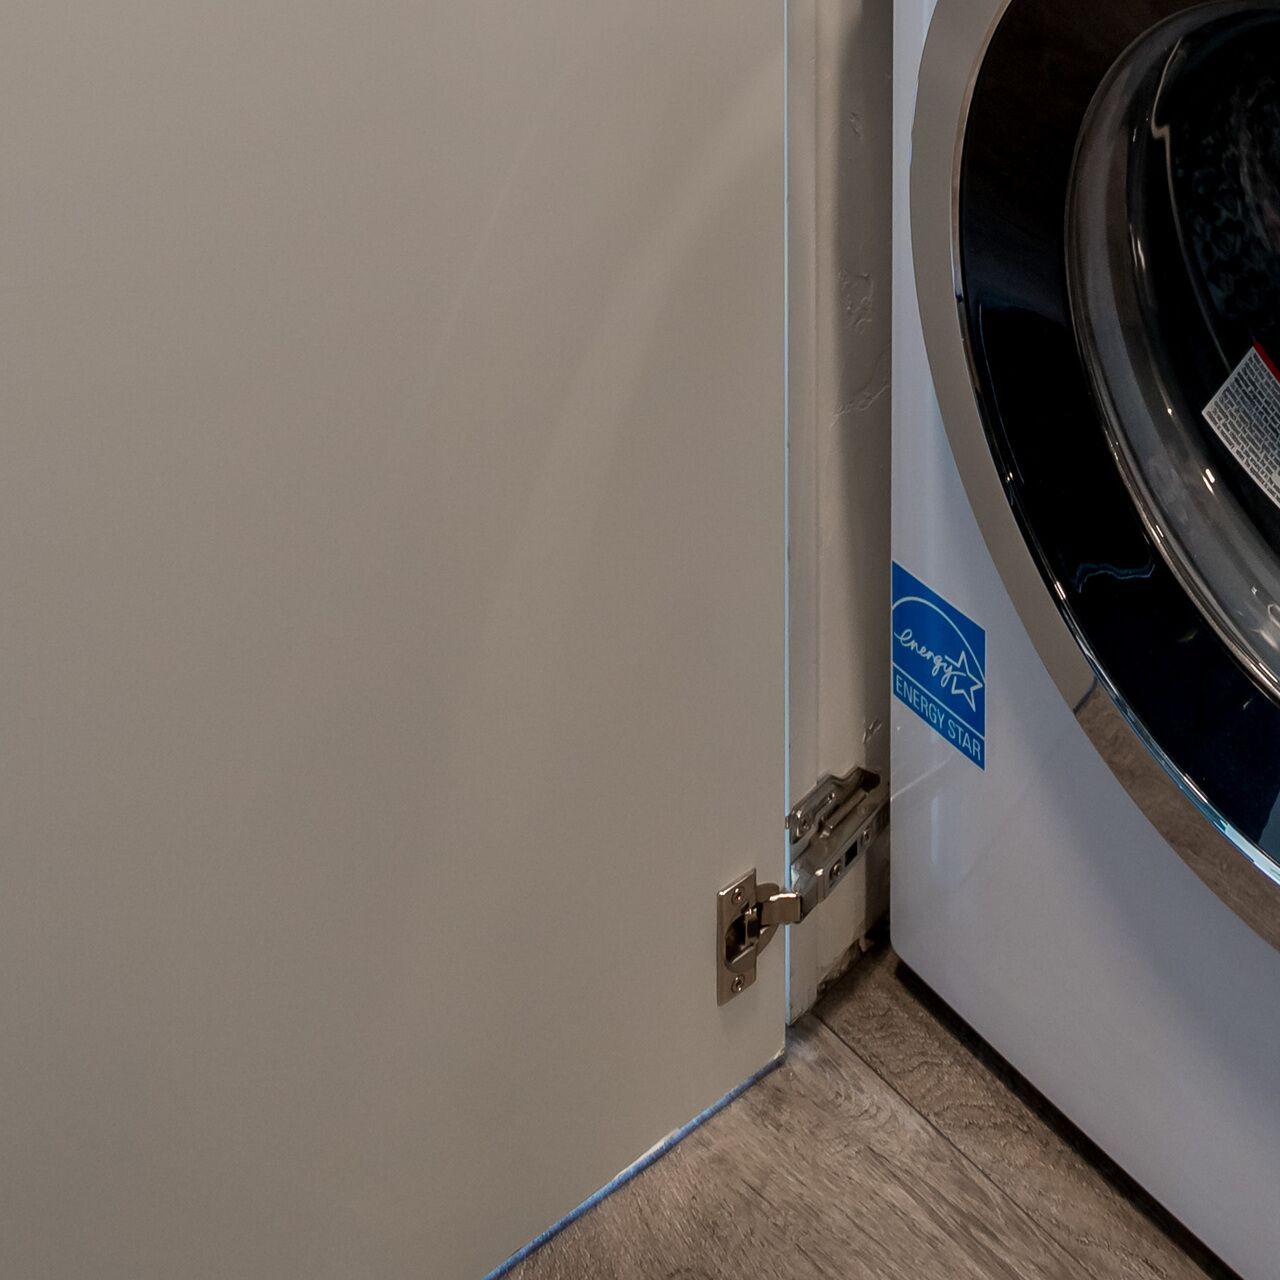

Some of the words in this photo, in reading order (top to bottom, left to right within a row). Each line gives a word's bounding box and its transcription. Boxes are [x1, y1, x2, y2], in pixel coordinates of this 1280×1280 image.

[893, 629, 967, 687] energy
[895, 674, 945, 729] ENERGY
[947, 719, 982, 761] STAR
